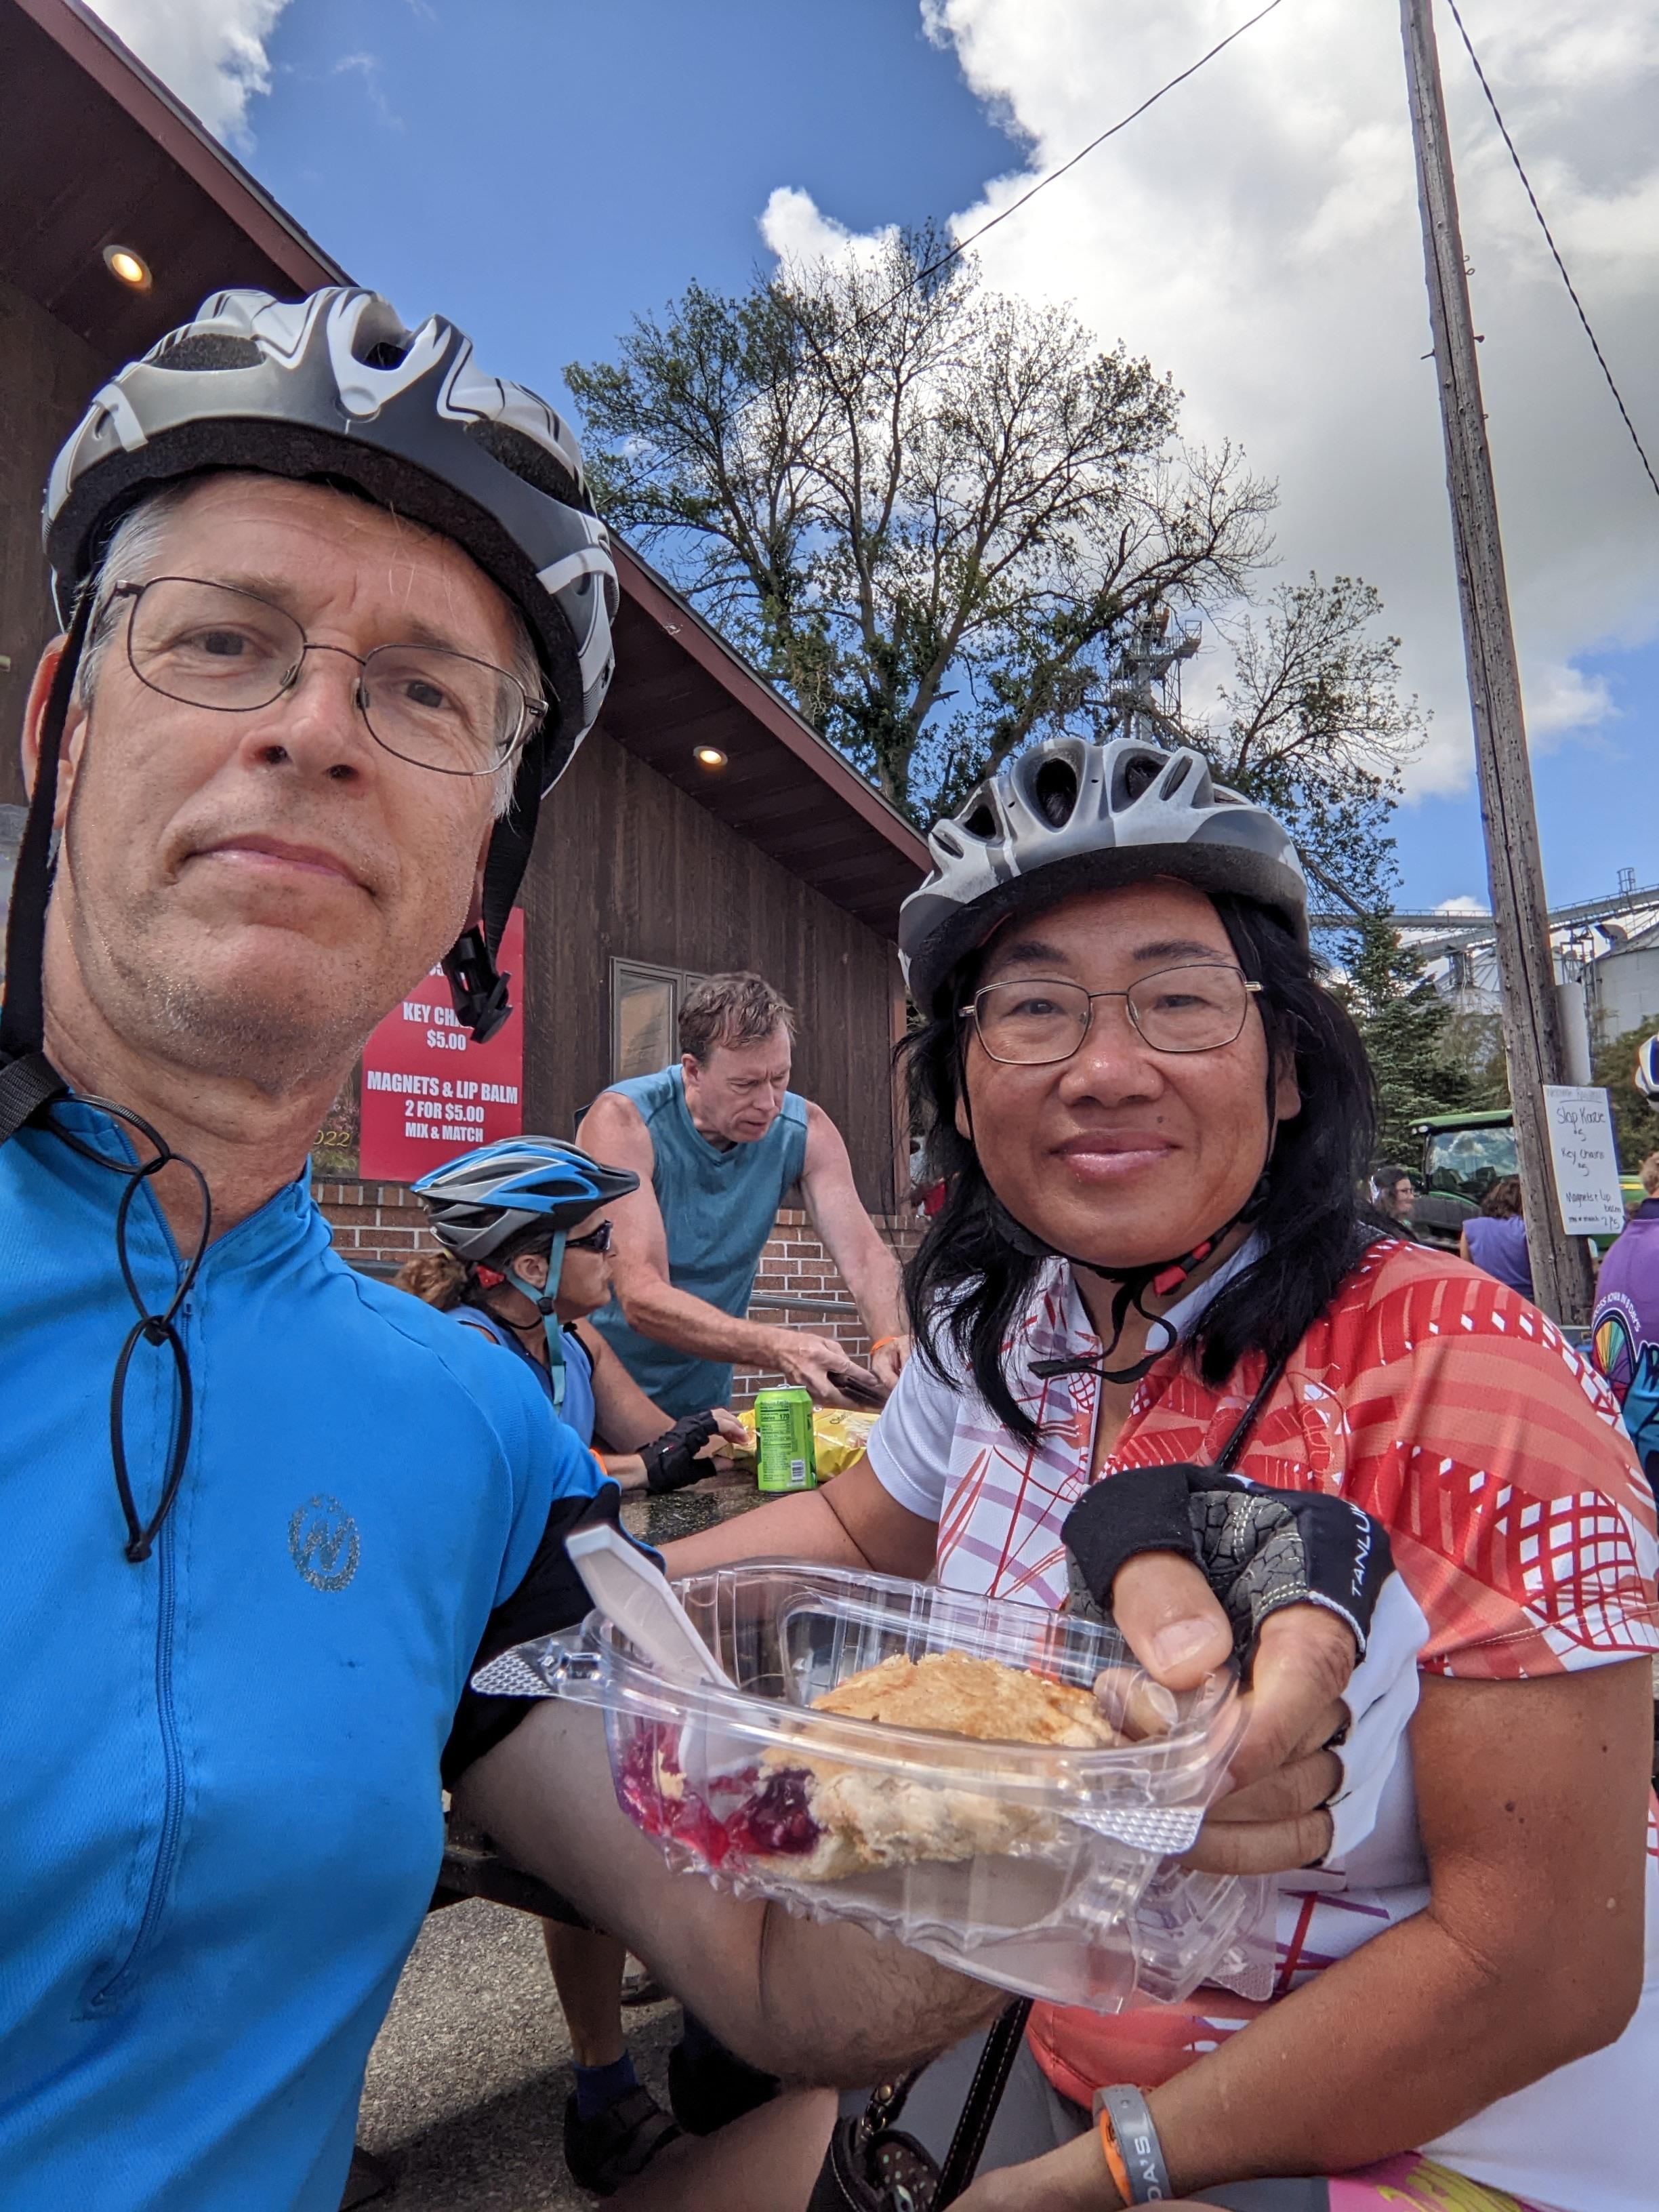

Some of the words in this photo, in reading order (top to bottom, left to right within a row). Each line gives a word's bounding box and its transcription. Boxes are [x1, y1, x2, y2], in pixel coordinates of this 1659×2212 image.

[403, 1002, 431, 1023] KEY
[427, 1029, 466, 1051] $5.00
[367, 1070, 439, 1097] MAGNETS
[442, 1082, 453, 1098] &
[456, 1080, 478, 1100] LIP
[481, 1083, 518, 1105] BALM
[405, 1100, 414, 1117] 2
[417, 1101, 442, 1119] FOR
[445, 1103, 485, 1123] $5.00
[405, 1122, 428, 1139] MIX
[430, 1126, 439, 1139] &
[442, 1126, 483, 1143] MATCH
[1561, 1147, 1576, 1166] Key
